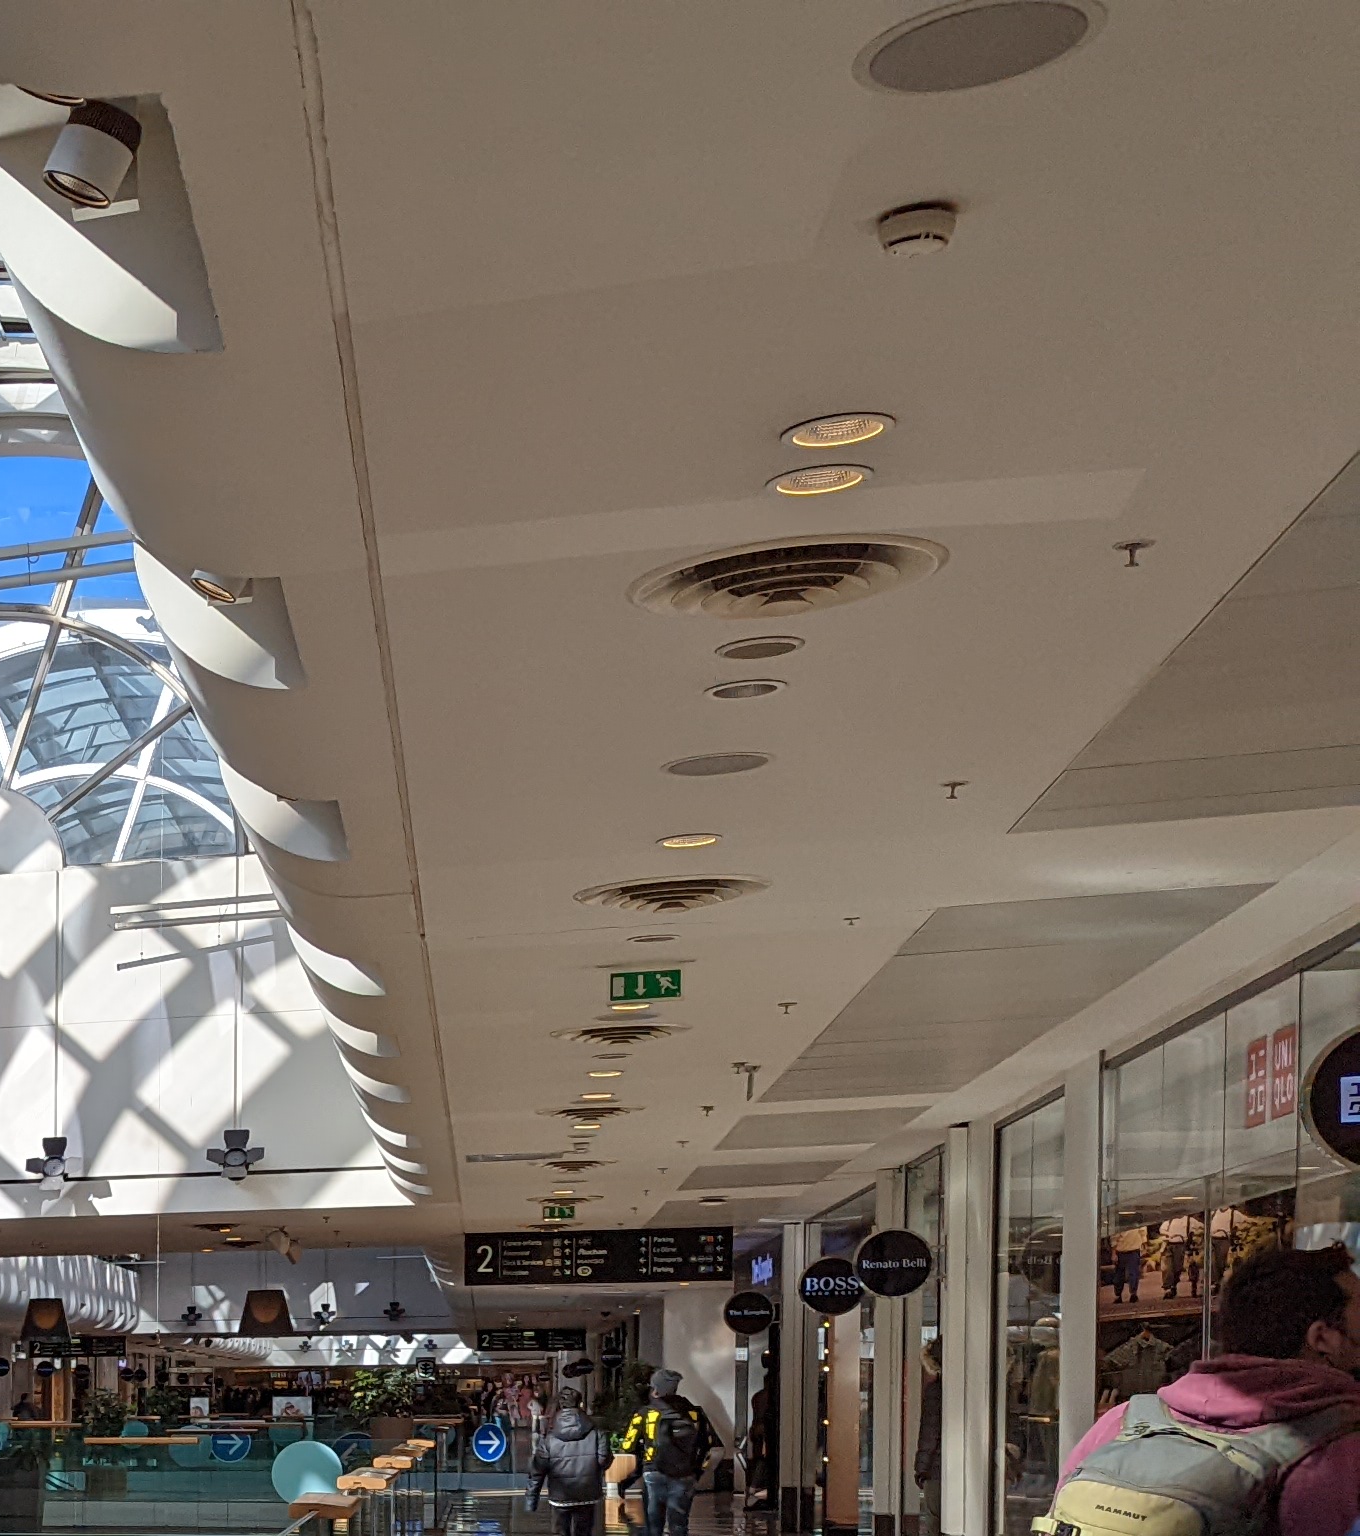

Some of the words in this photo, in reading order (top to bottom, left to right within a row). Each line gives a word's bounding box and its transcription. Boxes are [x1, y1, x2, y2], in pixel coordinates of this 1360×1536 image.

[1273, 1036, 1293, 1070] UNI
[1273, 1073, 1294, 1111] QLO
[476, 1244, 494, 1273] 2
[861, 1258, 900, 1270] Renato
[901, 1257, 927, 1269] Belli
[805, 1276, 859, 1291] BOSS
[1094, 1504, 1148, 1521] MAMMUT
